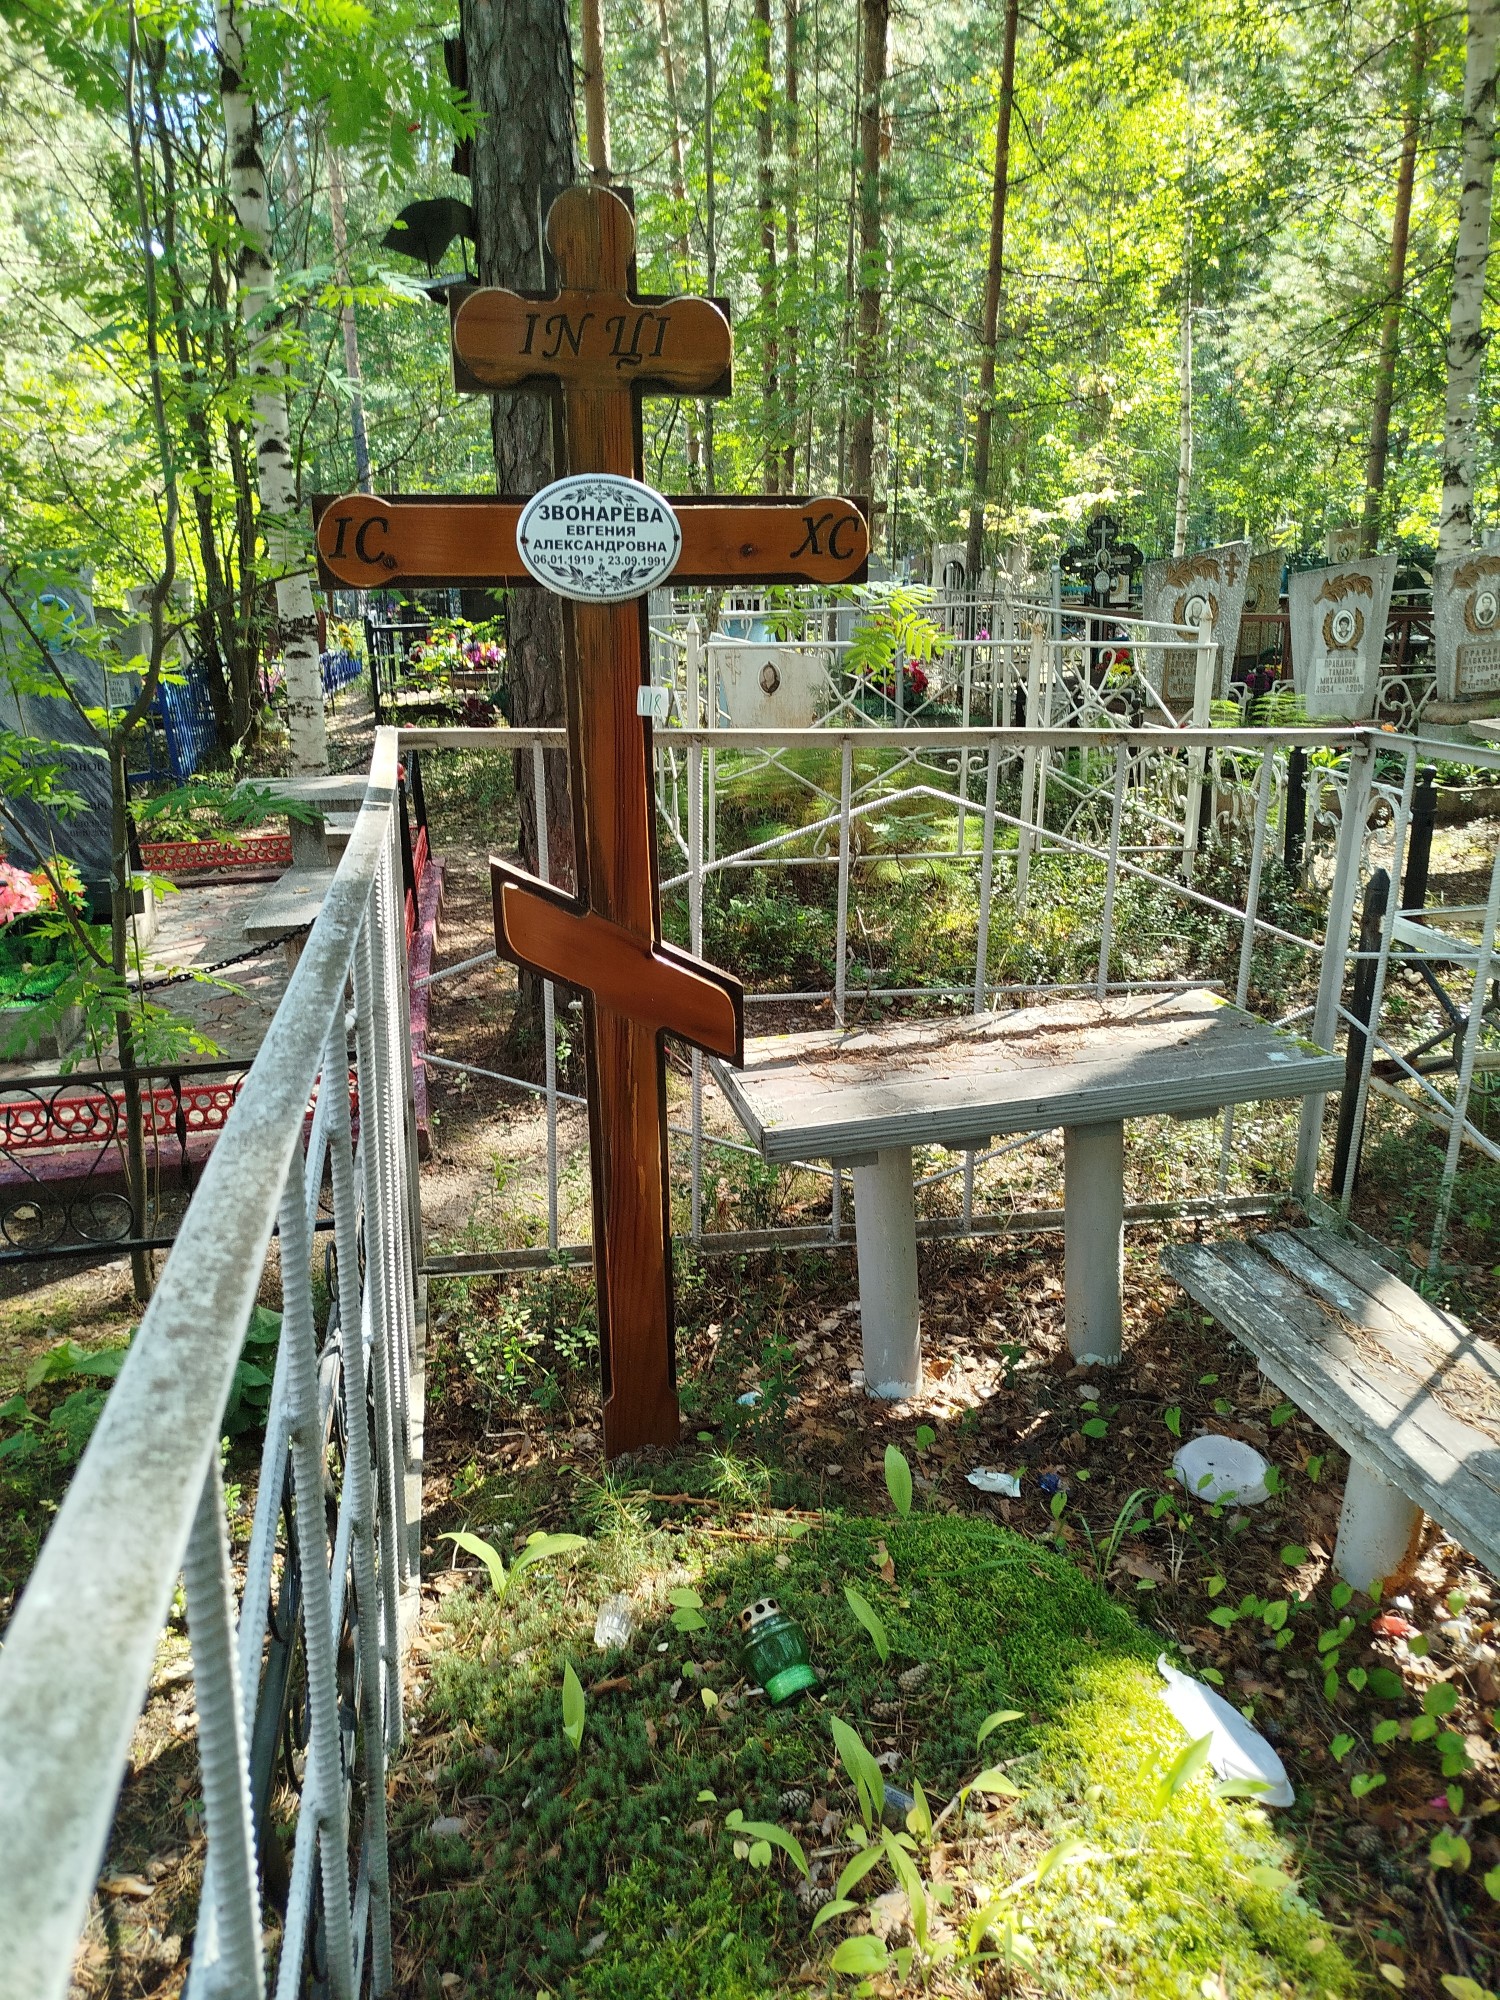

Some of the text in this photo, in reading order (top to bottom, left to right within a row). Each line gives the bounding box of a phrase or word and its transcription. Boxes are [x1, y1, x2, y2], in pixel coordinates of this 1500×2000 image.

[538, 503, 664, 523] ЗВОНАРЁВА
[566, 525, 636, 537] ЕВГЕНИЯ
[533, 539, 667, 553] АЛЕКСАНДРОВНА
[533, 555, 666, 567] 06.01.1919 23.09.1991
